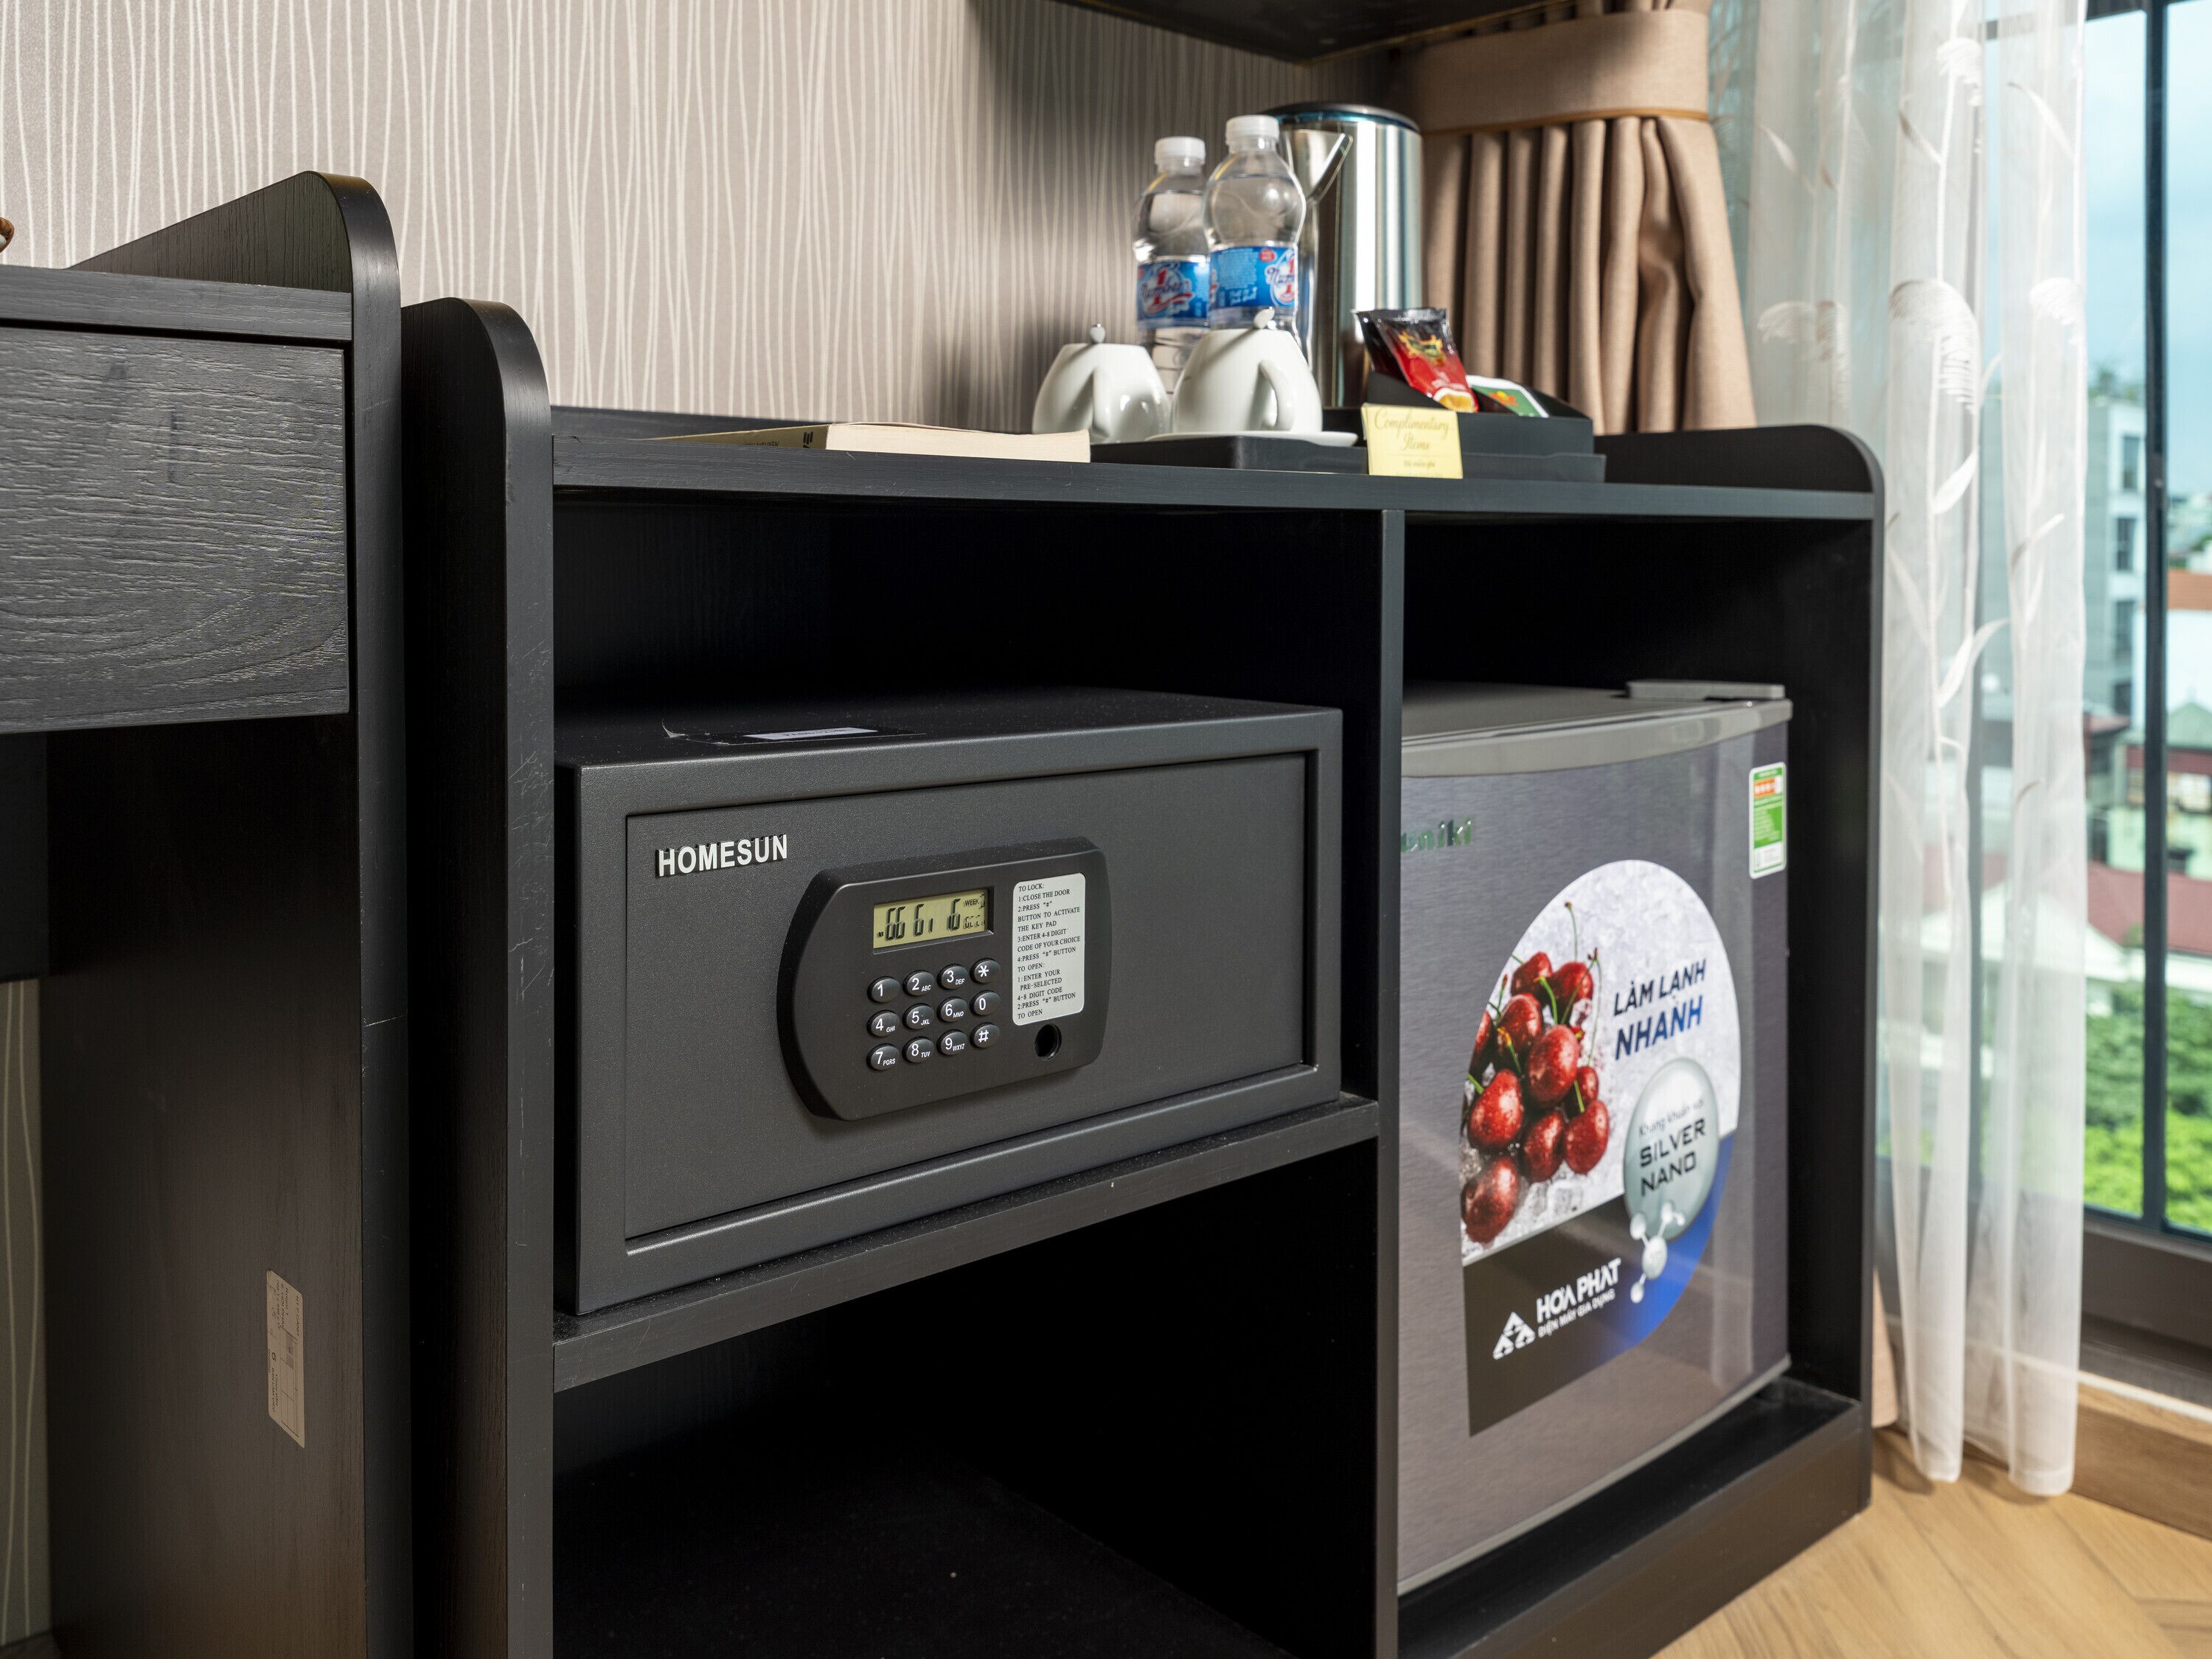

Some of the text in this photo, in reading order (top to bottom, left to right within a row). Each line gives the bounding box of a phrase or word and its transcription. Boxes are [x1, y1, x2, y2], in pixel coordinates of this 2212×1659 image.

[658, 834, 787, 877] HOMESUN
[1027, 883, 1045, 891] LOCK:
[1054, 888, 1070, 897] DOOR
[964, 899, 979, 907] WEEK
[1018, 913, 1041, 922] BUTTON
[1053, 907, 1081, 917] ACTIVATE
[1051, 928, 1067, 936] DIGIT
[1043, 939, 1059, 947] YOUR
[1060, 936, 1081, 944] CHOICE
[1053, 947, 1076, 956] BUTTON
[1027, 962, 1045, 970] OPEN:
[947, 970, 954, 983] 3
[1044, 969, 1060, 977] YOUR
[911, 977, 919, 991] 2
[1020, 977, 1062, 990] PRE-SELECTED
[1614, 959, 1707, 1016] LÀM LẠNH
[877, 984, 883, 997] 1
[1029, 990, 1045, 999] DIGIT
[1047, 987, 1063, 995] CODE
[1053, 992, 1076, 1002] BUTTON
[945, 1004, 953, 1016] 6
[978, 998, 987, 1011] 0
[911, 1011, 919, 1024] 5
[1027, 1009, 1043, 1017] OPEN
[875, 1018, 884, 1032] 4
[1615, 995, 1703, 1060] NHANH
[911, 1043, 919, 1057] 8
[945, 1037, 965, 1051] 9 WXYZ
[875, 1051, 883, 1065] 7
[1640, 1118, 1705, 1168] SILVER
[1641, 1151, 1696, 1198] NANO
